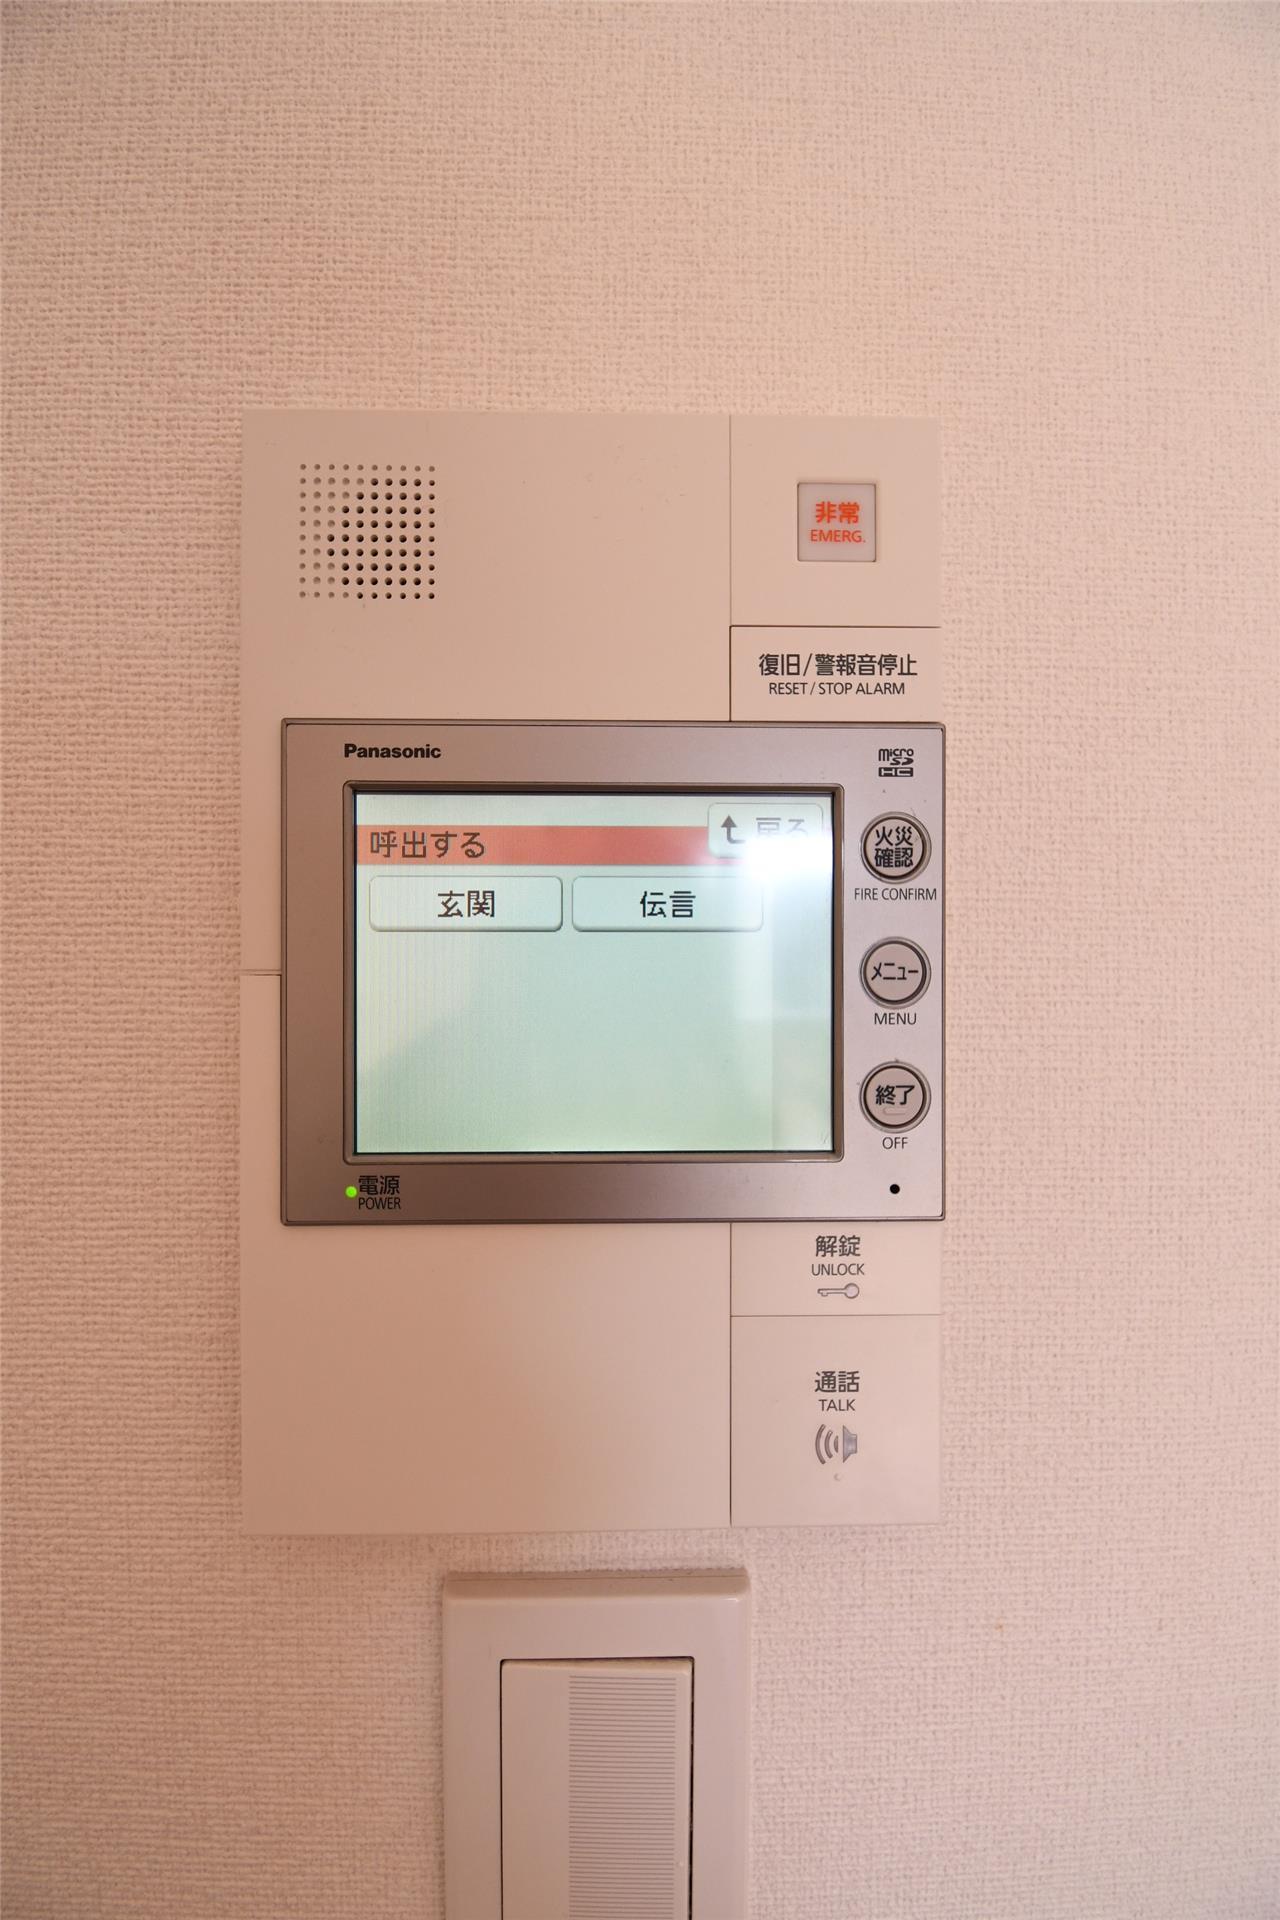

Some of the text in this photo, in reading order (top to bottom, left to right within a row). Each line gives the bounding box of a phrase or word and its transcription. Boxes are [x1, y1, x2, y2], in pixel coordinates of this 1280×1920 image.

[815, 501, 859, 524] 非常
[810, 529, 866, 543] EMERG.
[759, 653, 917, 676] 復旧/警報音停止
[855, 682, 905, 695] ALARM
[344, 744, 441, 758] Panasonic
[371, 831, 484, 858] 呼出する
[875, 826, 914, 846] 火災
[874, 847, 914, 868] 確認
[438, 891, 494, 917] 玄関
[640, 891, 696, 917] 伝言
[855, 888, 936, 900] FIRE CONFIRM
[871, 962, 919, 981] メニュー
[873, 1012, 917, 1025] MENU
[876, 1085, 915, 1105] 終了
[882, 1137, 908, 1150] OFF
[358, 1175, 401, 1196] 電源
[358, 1196, 402, 1211] POWER
[816, 1235, 860, 1257] 解錠
[812, 1263, 864, 1276] UNLOCK
[815, 1371, 860, 1392] 通話
[818, 1399, 855, 1411] TALK
